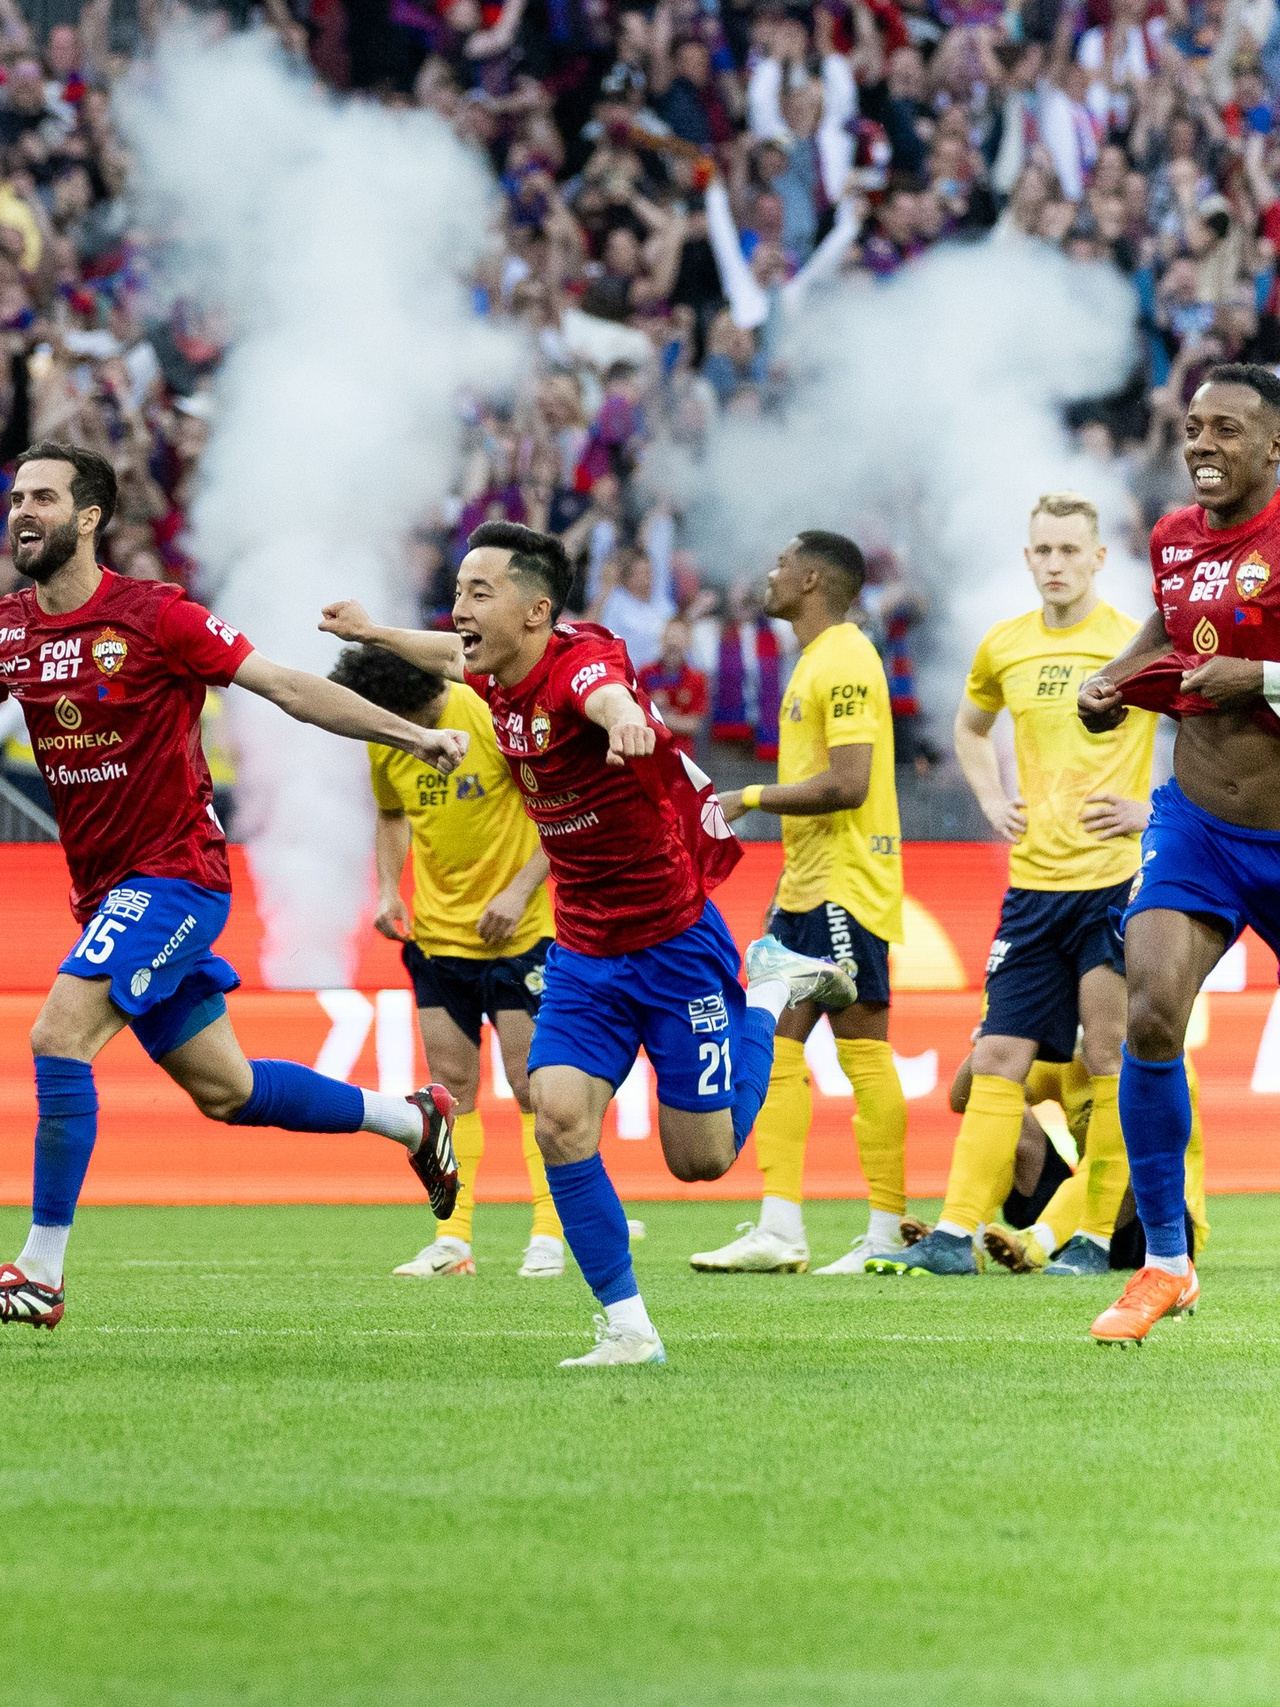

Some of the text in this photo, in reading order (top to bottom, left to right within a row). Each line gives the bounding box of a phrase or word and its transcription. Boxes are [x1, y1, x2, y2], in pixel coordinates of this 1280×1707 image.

[1193, 560, 1233, 581] FON
[1188, 579, 1230, 602] BET
[39, 638, 81, 662] FON
[94, 642, 125, 657] ЦСКА
[41, 658, 83, 682] BET
[571, 662, 607, 693] FON
[1037, 665, 1073, 680] FON
[831, 684, 867, 700] FON
[1036, 681, 1069, 697] BET
[834, 701, 865, 718] BET
[38, 731, 123, 750] APOTHEKA
[58, 761, 128, 785] билайн
[416, 773, 448, 789] FON
[419, 790, 448, 806] BET
[74, 914, 127, 964] 15
[151, 914, 198, 969] РОССЕТИ
[698, 1037, 732, 1096] 21
